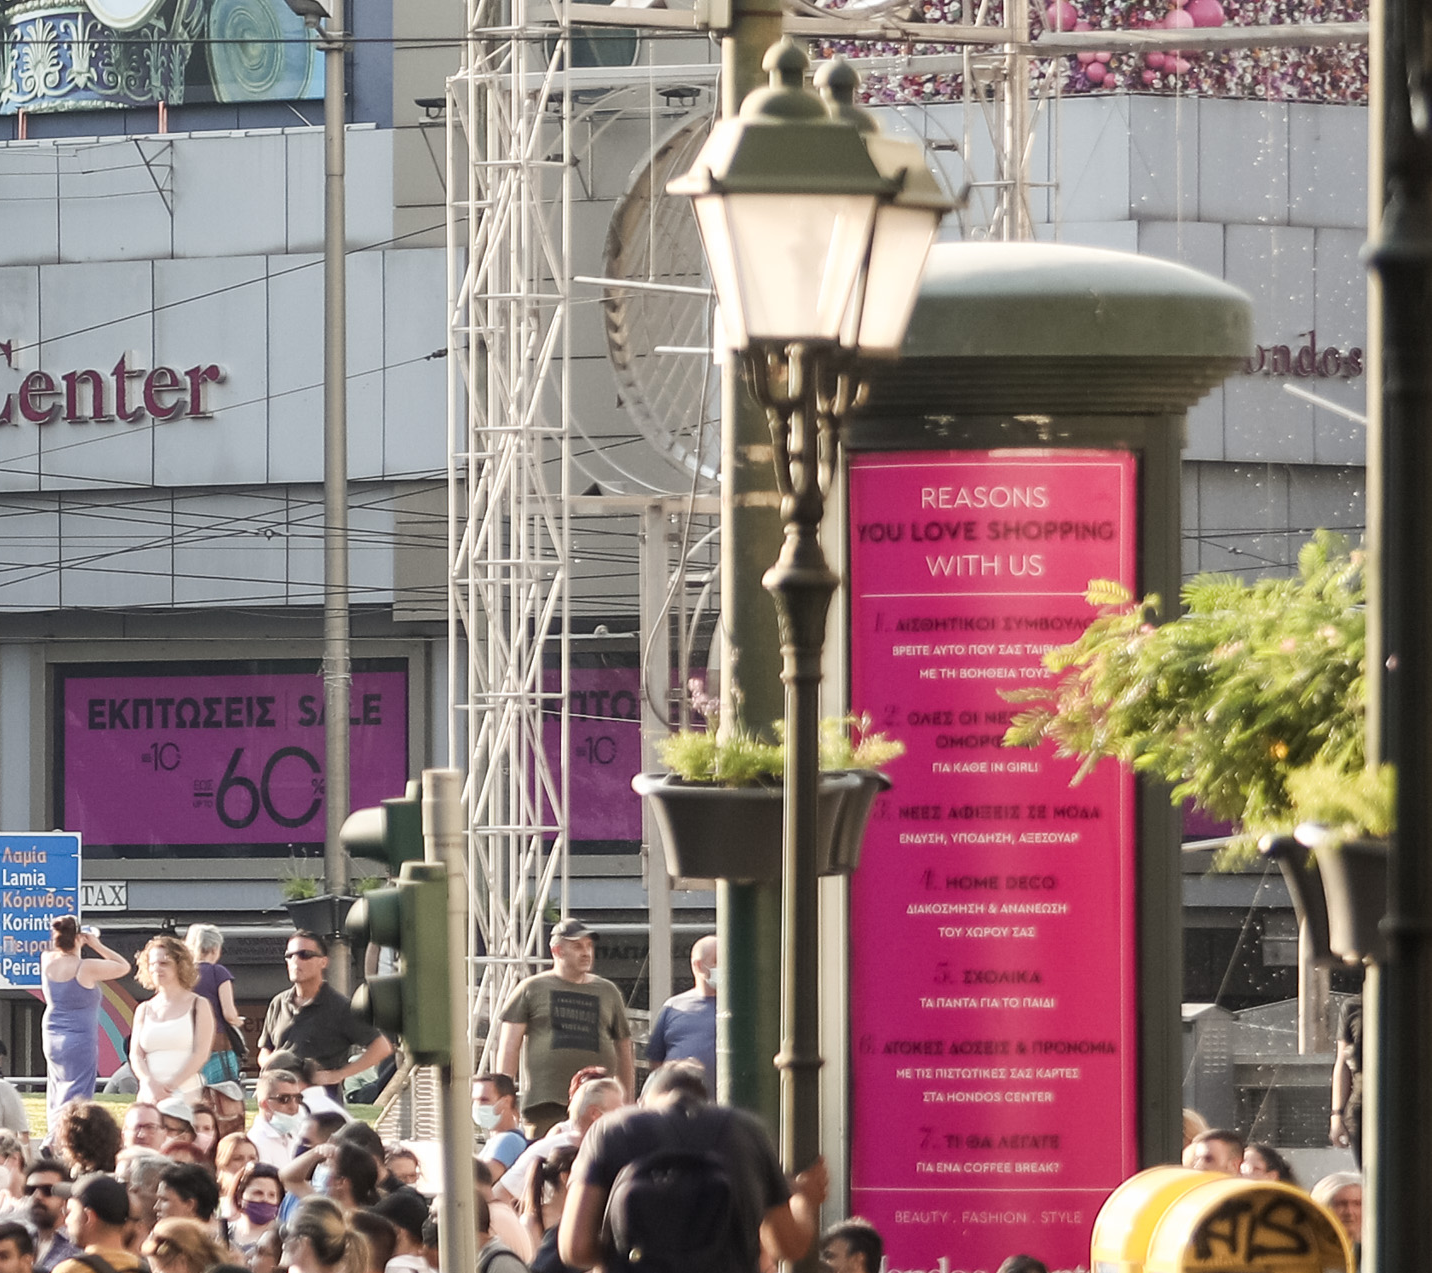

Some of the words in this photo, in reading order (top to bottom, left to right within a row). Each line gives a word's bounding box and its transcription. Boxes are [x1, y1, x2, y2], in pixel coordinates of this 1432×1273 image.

[1244, 329, 1364, 378] ondos
[921, 486, 1048, 509] REASONS
[857, 522, 902, 543] YOU
[910, 521, 977, 542] LOVE
[986, 520, 1115, 541] SHOPPING
[926, 554, 998, 577] WITH
[1008, 553, 1043, 576] US
[892, 645, 930, 657] ΒΡΕΙΤΕ
[932, 645, 965, 657] ΑΥΤΟ
[968, 645, 996, 657] ΠΟΥ
[998, 645, 1023, 656] ΣΑΣ
[919, 668, 937, 680] ΜΕ
[940, 668, 956, 680] ΤΗ
[959, 668, 1016, 680] ΒΟΗΘΕΙΑ
[1020, 668, 1051, 679] ΤΟΥΣ
[87, 696, 276, 730] ΕΚΠΤΩΣΕΙΣ
[932, 762, 951, 774] ΓΙΑ
[953, 762, 988, 774] ΚΑΘΕ
[1007, 762, 1039, 774] GIRL!
[1018, 832, 1079, 844] ΑΞΕΣΟΥΑΡ
[2, 845, 48, 867] Λαμία
[2, 868, 47, 887] Lamia
[946, 875, 999, 890] HOME
[1003, 875, 1056, 890] DECO
[2, 890, 75, 913] Κόρινθος
[81, 884, 127, 907] TAX
[906, 904, 985, 915] ΔΙΑΚΟΣΜΗΣΗ
[987, 904, 997, 915] &
[1000, 904, 1068, 915] ΑΝΑΝΕΩΣΗ
[938, 927, 962, 938] ΤΟΥ
[965, 927, 1009, 938] ΧΩΡΟΥ
[1012, 927, 1036, 938] ΣΑΣ
[962, 970, 1041, 985] ΣΧΟΛΙΚΑ
[919, 997, 934, 1009] ΤΑ
[936, 997, 978, 1009] ΠΑΝΤΑ
[980, 997, 999, 1009] ΓΙΑ
[1001, 997, 1019, 1009] ΤΟ
[1022, 997, 1055, 1009] ΠΑΙΔΙ
[896, 1068, 912, 1080] ΜΕ
[914, 1068, 932, 1080] ΤΙΣ
[935, 1068, 1006, 1079] ΠΙΣΤΩΤΙΚΕΣ
[1009, 1068, 1033, 1079] ΣΑΣ
[1036, 1068, 1080, 1079] ΚΑΡΤΕΣ
[923, 1091, 944, 1103] ΣΤΑ
[947, 1091, 1002, 1103] HONDOS
[1005, 1091, 1054, 1103] CENTER
[916, 1162, 934, 1174] ΓΙΑ
[936, 1162, 961, 1174] ΕΝΑ
[963, 1162, 1011, 1174] COFFEE
[1014, 1162, 1060, 1174] BREAK?
[894, 1211, 947, 1225] BEAUTY
[961, 1211, 1027, 1225] FASHION
[1040, 1211, 1082, 1224] STYLE
